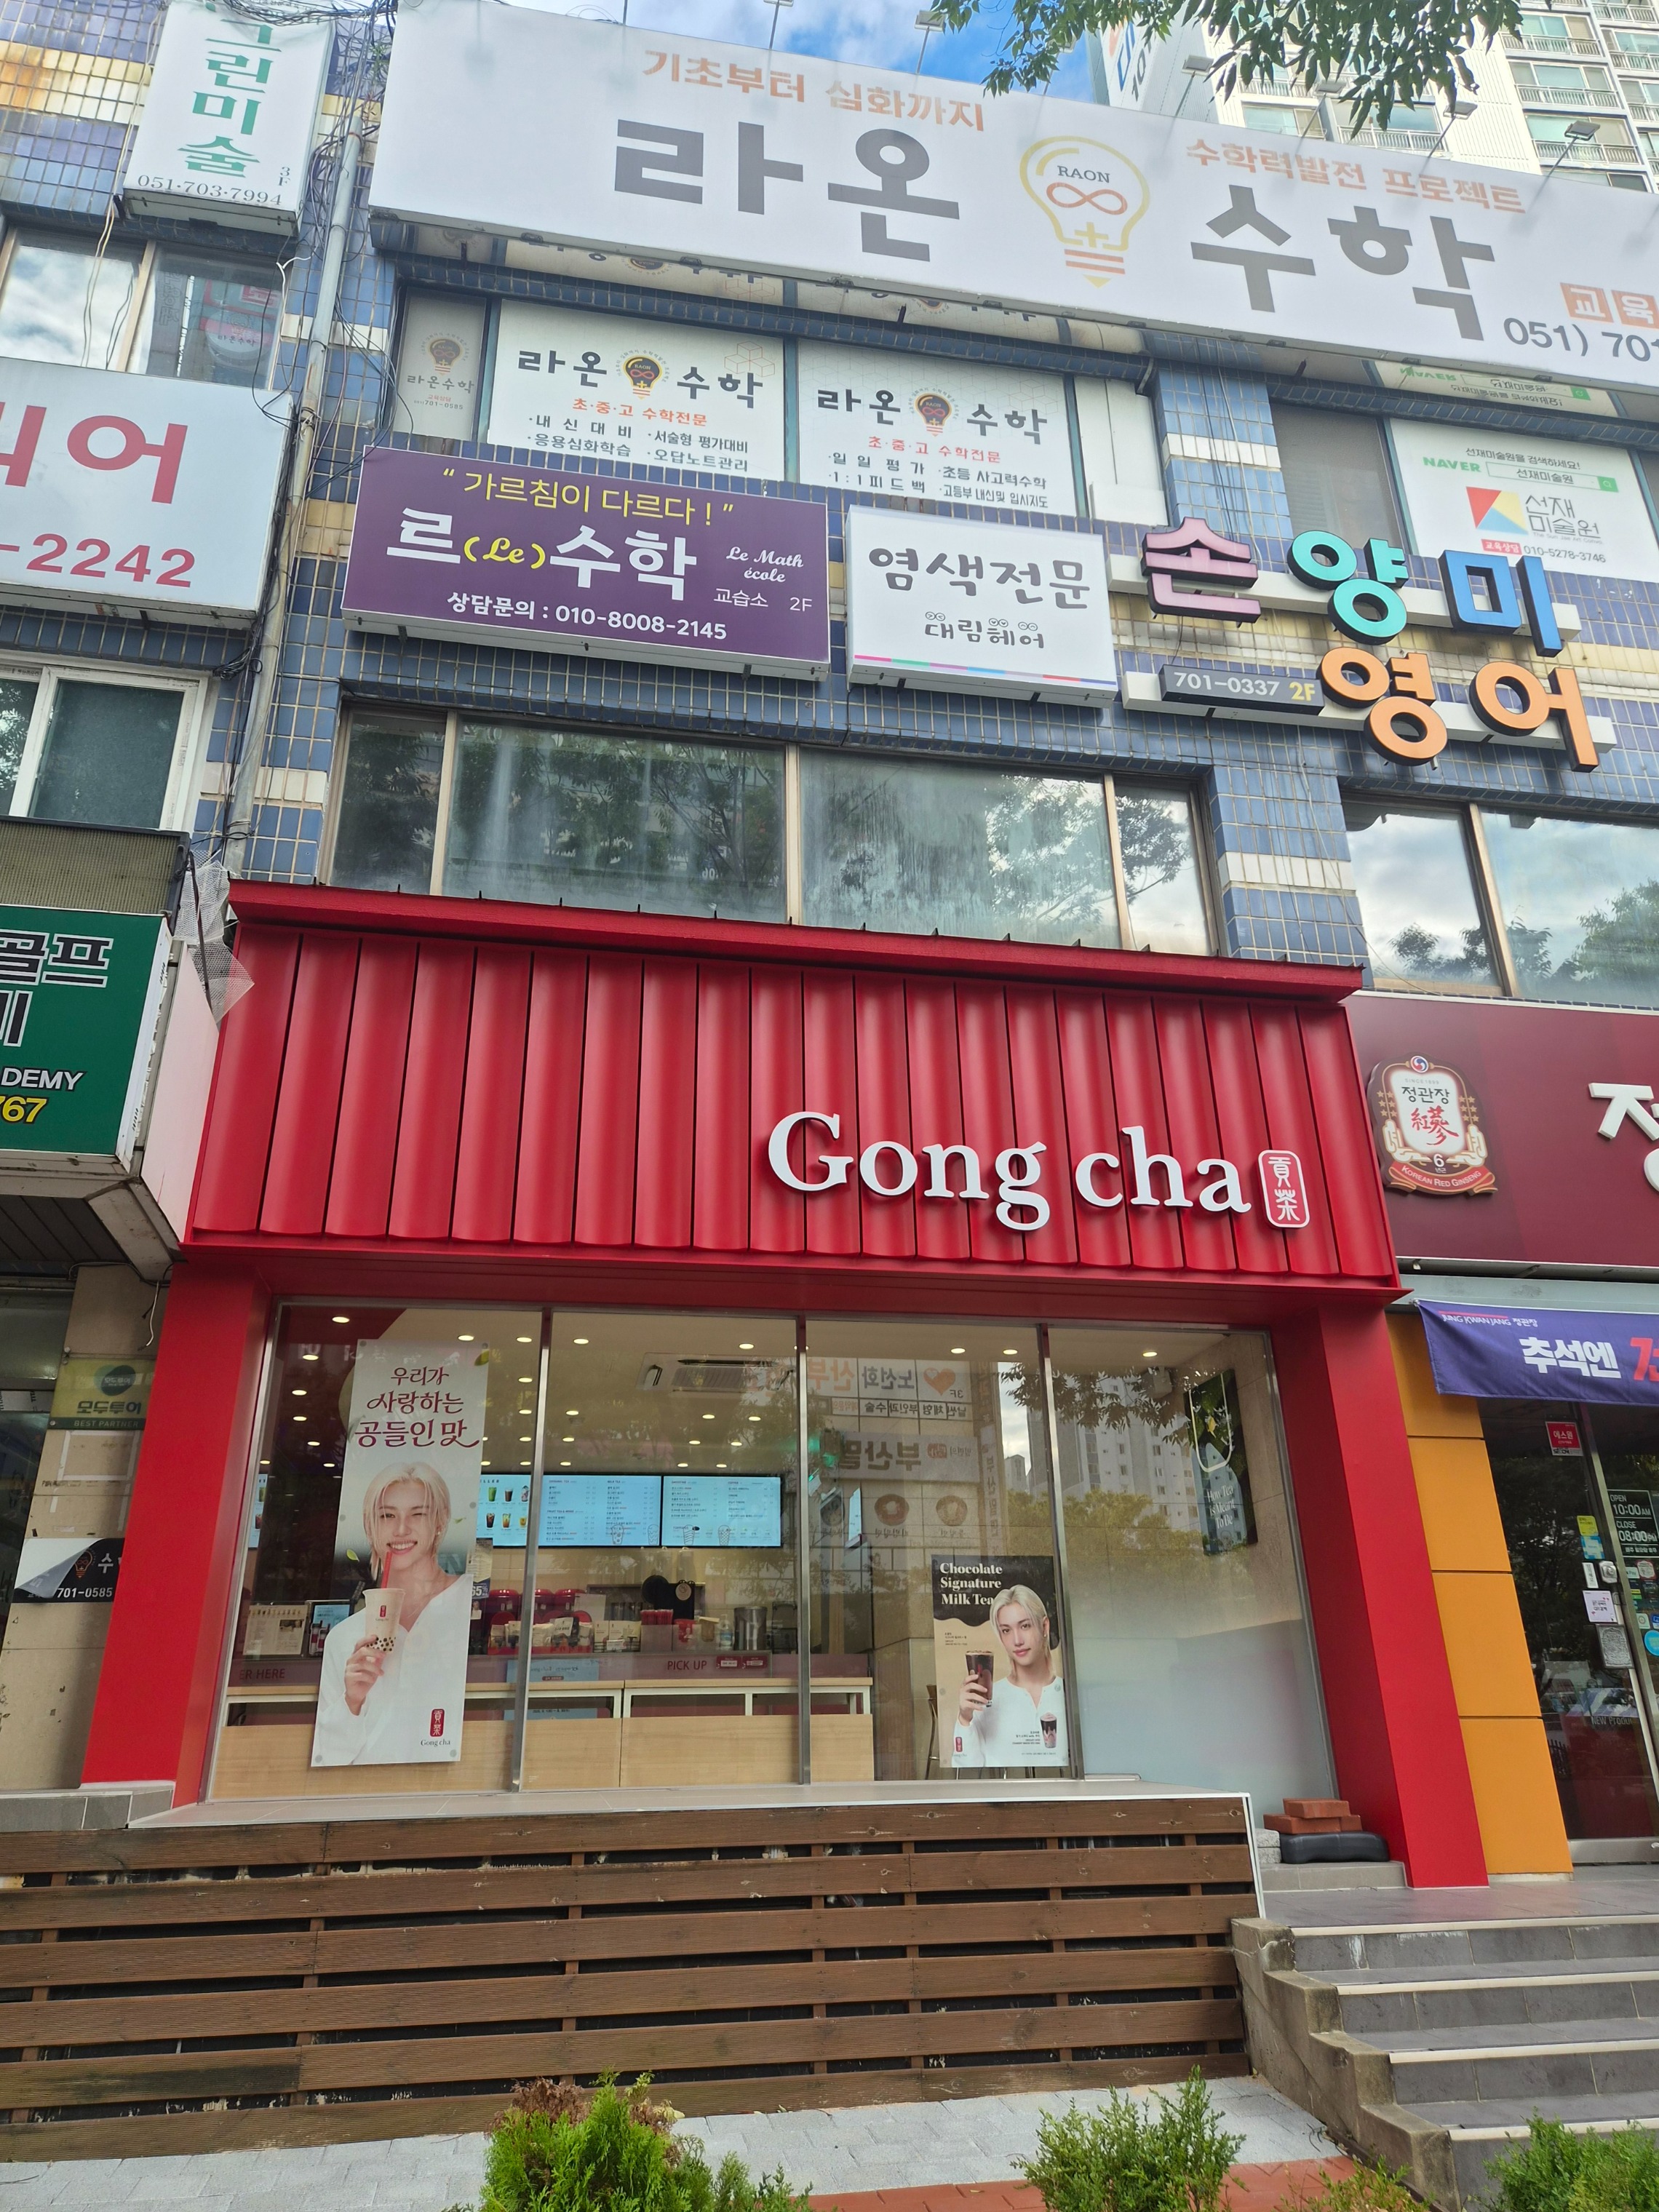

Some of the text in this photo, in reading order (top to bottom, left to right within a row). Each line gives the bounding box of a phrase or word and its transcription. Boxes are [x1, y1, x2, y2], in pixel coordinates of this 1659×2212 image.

[642, 49, 985, 132] 기초부터 심화까지
[1057, 164, 1111, 184] RAON
[1186, 138, 1527, 214] 수학력발전 프로젝트
[614, 119, 960, 263] 라온
[1190, 184, 1495, 342] 수학
[1503, 317, 1589, 357] 051)
[518, 350, 608, 388] 라온
[407, 375, 475, 394] 라온수학
[677, 367, 764, 409] 수학
[642, 406, 708, 427] 수학전문
[817, 389, 902, 426] 라온
[966, 403, 1048, 445] 수학
[698, 432, 749, 454] 평가대비
[938, 444, 1001, 464] 수학전문
[1422, 456, 1481, 473] NAVER
[1465, 447, 1581, 470] 선재미술원을 검색하세요!
[976, 469, 1046, 490] 사고력수학
[1515, 468, 1575, 485] 선재미술원
[1010, 491, 1049, 509] 입시지도
[1524, 494, 1576, 519] 선재
[1528, 514, 1602, 539] 미술원
[725, 546, 805, 569] Le Math
[1484, 541, 1520, 554] 교육상담
[1524, 545, 1607, 563] 010-5278-3746
[868, 547, 1090, 610] 염색전문
[712, 588, 812, 612] 교습소 2F
[446, 591, 535, 619] 상담문의
[554, 604, 728, 640] 010-8008-2145
[924, 615, 1045, 650] 대림헤어
[1173, 670, 1316, 703] 701-0337 2F
[1316, 646, 1599, 773] 영어
[1401, 1086, 1449, 1105] 정관장
[768, 1110, 1252, 1231] Gong cha
[1433, 1153, 1444, 1167] 6
[1401, 1165, 1482, 1187] KOREAN RED GINSENG
[1441, 1313, 1464, 1324] JUNG
[1512, 1317, 1538, 1327] 정관장
[1518, 1336, 1622, 1379] 추석엔
[390, 1366, 450, 1386] 우리가
[76, 1400, 143, 1415] 모두투어
[366, 1391, 464, 1414] 사랑하는
[354, 1419, 481, 1448] 공들인 맛
[1206, 1484, 1234, 1503] How Tea
[1610, 1494, 1627, 1503] OPEN
[1215, 1499, 1236, 1514] Meant
[1215, 1513, 1233, 1529] To Be
[1615, 1520, 1637, 1529] CLOSE
[939, 1562, 1003, 1575] Chocolate
[57, 1587, 114, 1599] 701-0585
[940, 1576, 1002, 1591] Signature
[941, 1593, 971, 1605] Milk
[256, 1668, 286, 1679] HERE
[667, 1660, 690, 1670] PICK
[693, 1660, 707, 1670] UP
[1591, 1716, 1607, 1726] NEW
[421, 1739, 438, 1748] Gong
